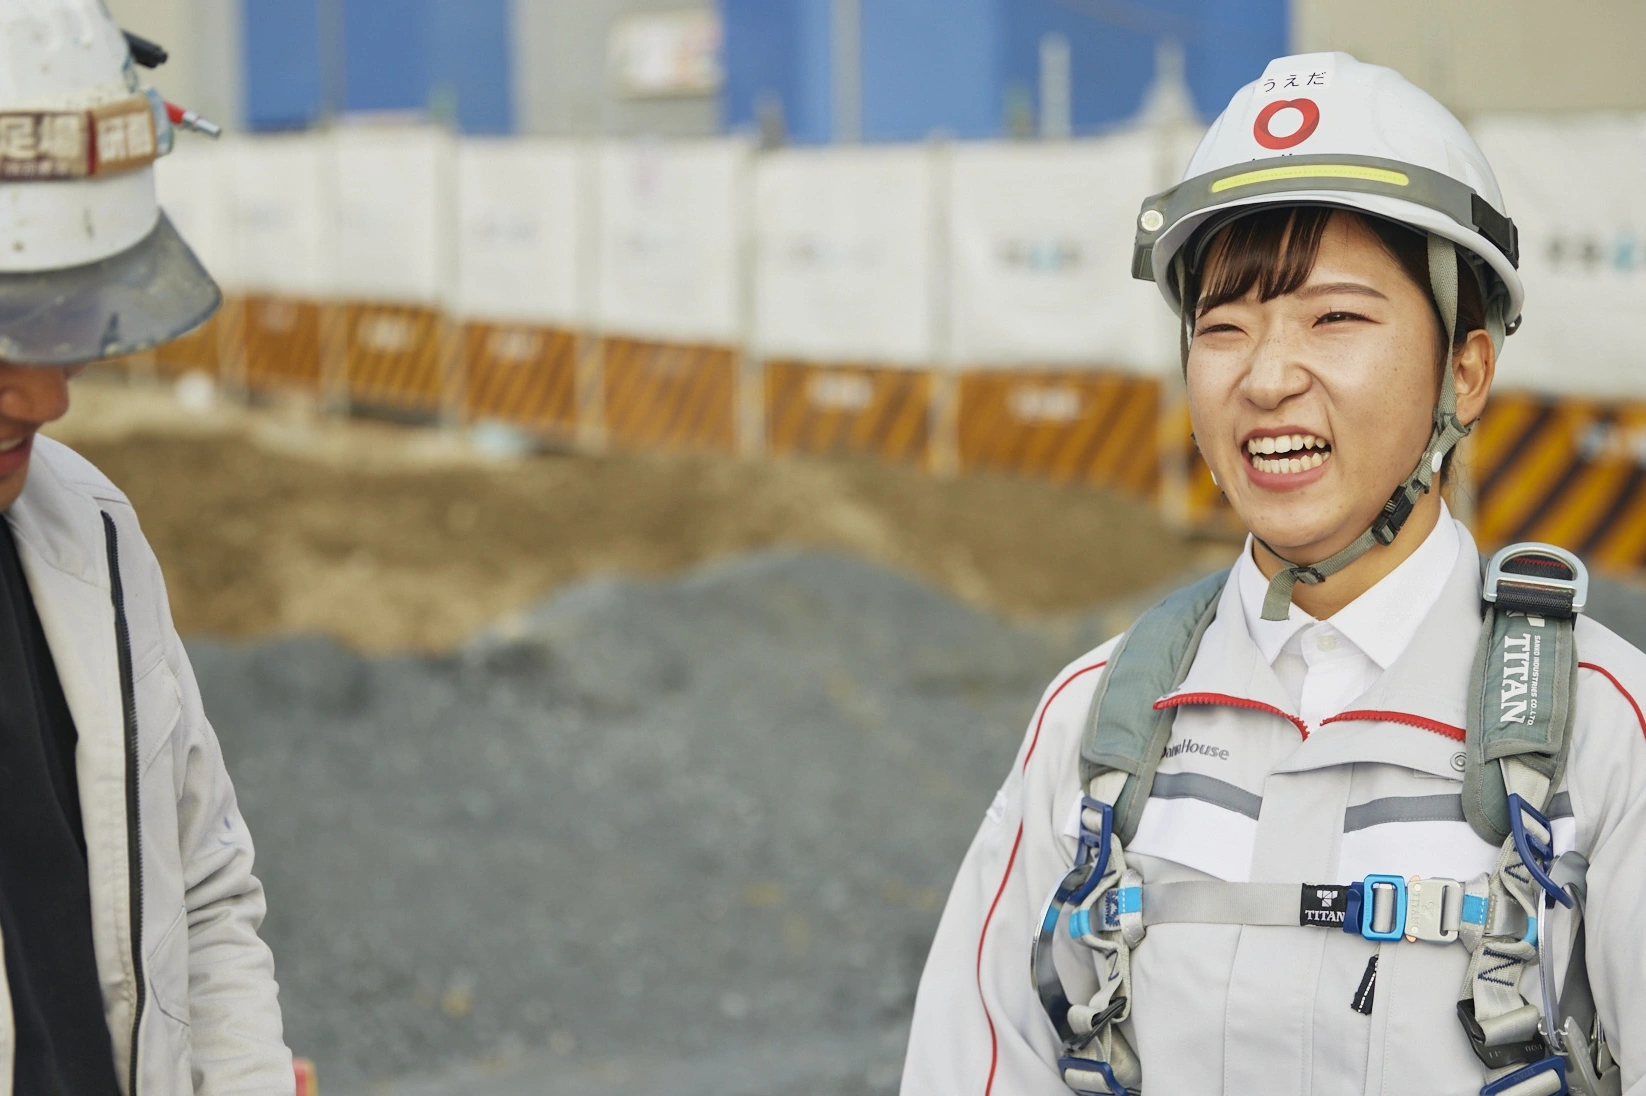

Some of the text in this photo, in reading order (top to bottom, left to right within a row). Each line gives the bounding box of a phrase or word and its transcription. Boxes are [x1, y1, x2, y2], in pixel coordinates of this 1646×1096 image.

[1263, 72, 1326, 92] うえだ
[1500, 633, 1531, 723] TITAN
[1531, 656, 1540, 698] INDUSTRIES
[1305, 910, 1345, 922] TITAN
